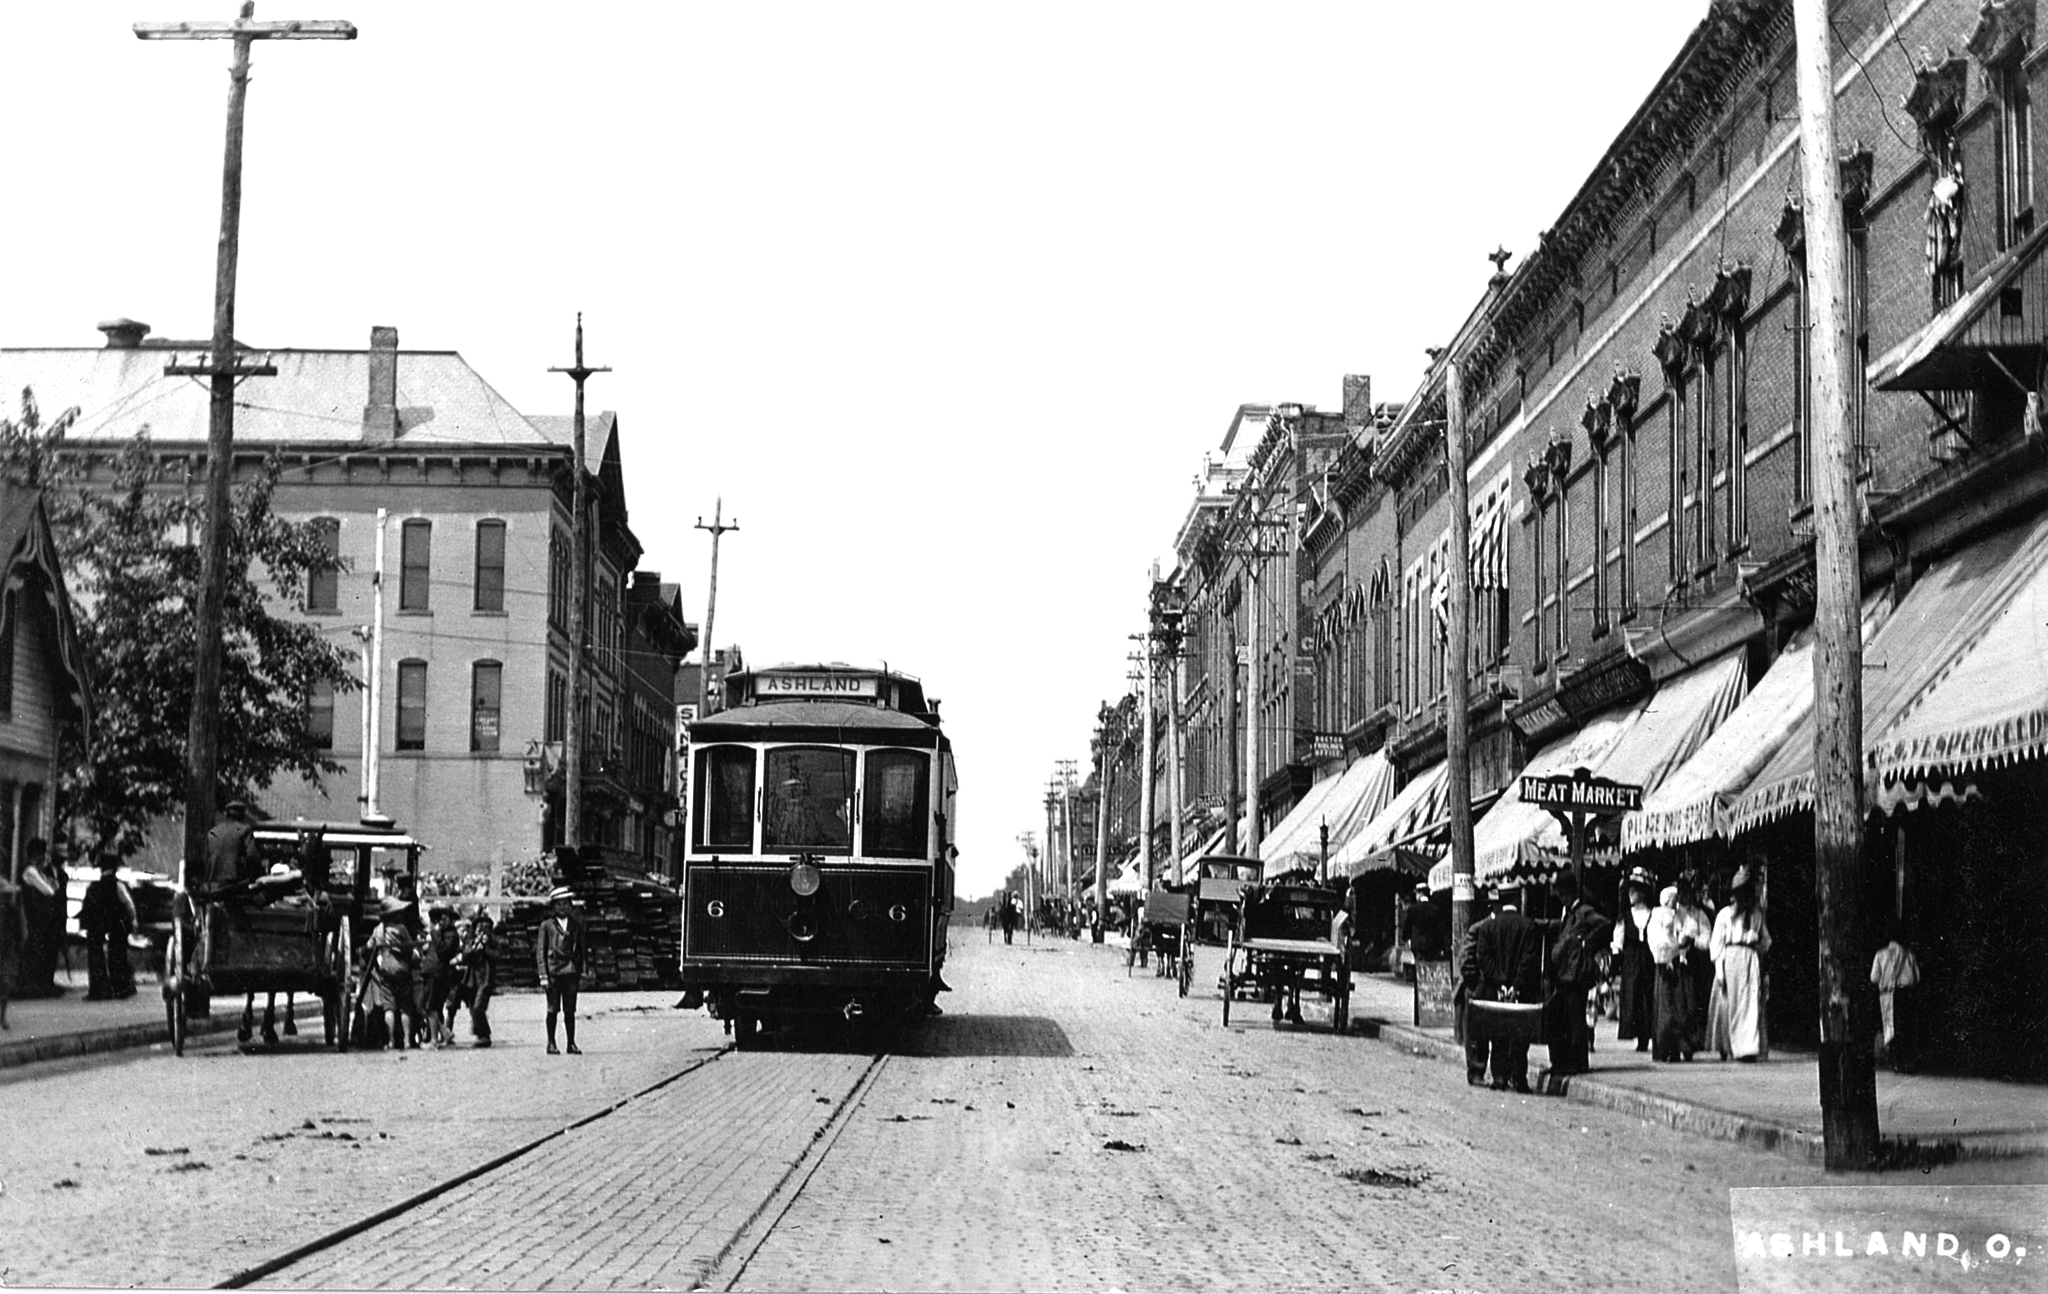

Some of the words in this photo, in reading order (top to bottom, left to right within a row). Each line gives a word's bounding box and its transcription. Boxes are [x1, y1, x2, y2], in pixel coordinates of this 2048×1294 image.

[767, 677, 861, 692] ASHLAND
[1524, 778, 1568, 803] MEAT
[1571, 781, 1639, 807] MARKET
[706, 900, 725, 918] 6
[888, 905, 908, 922] 6
